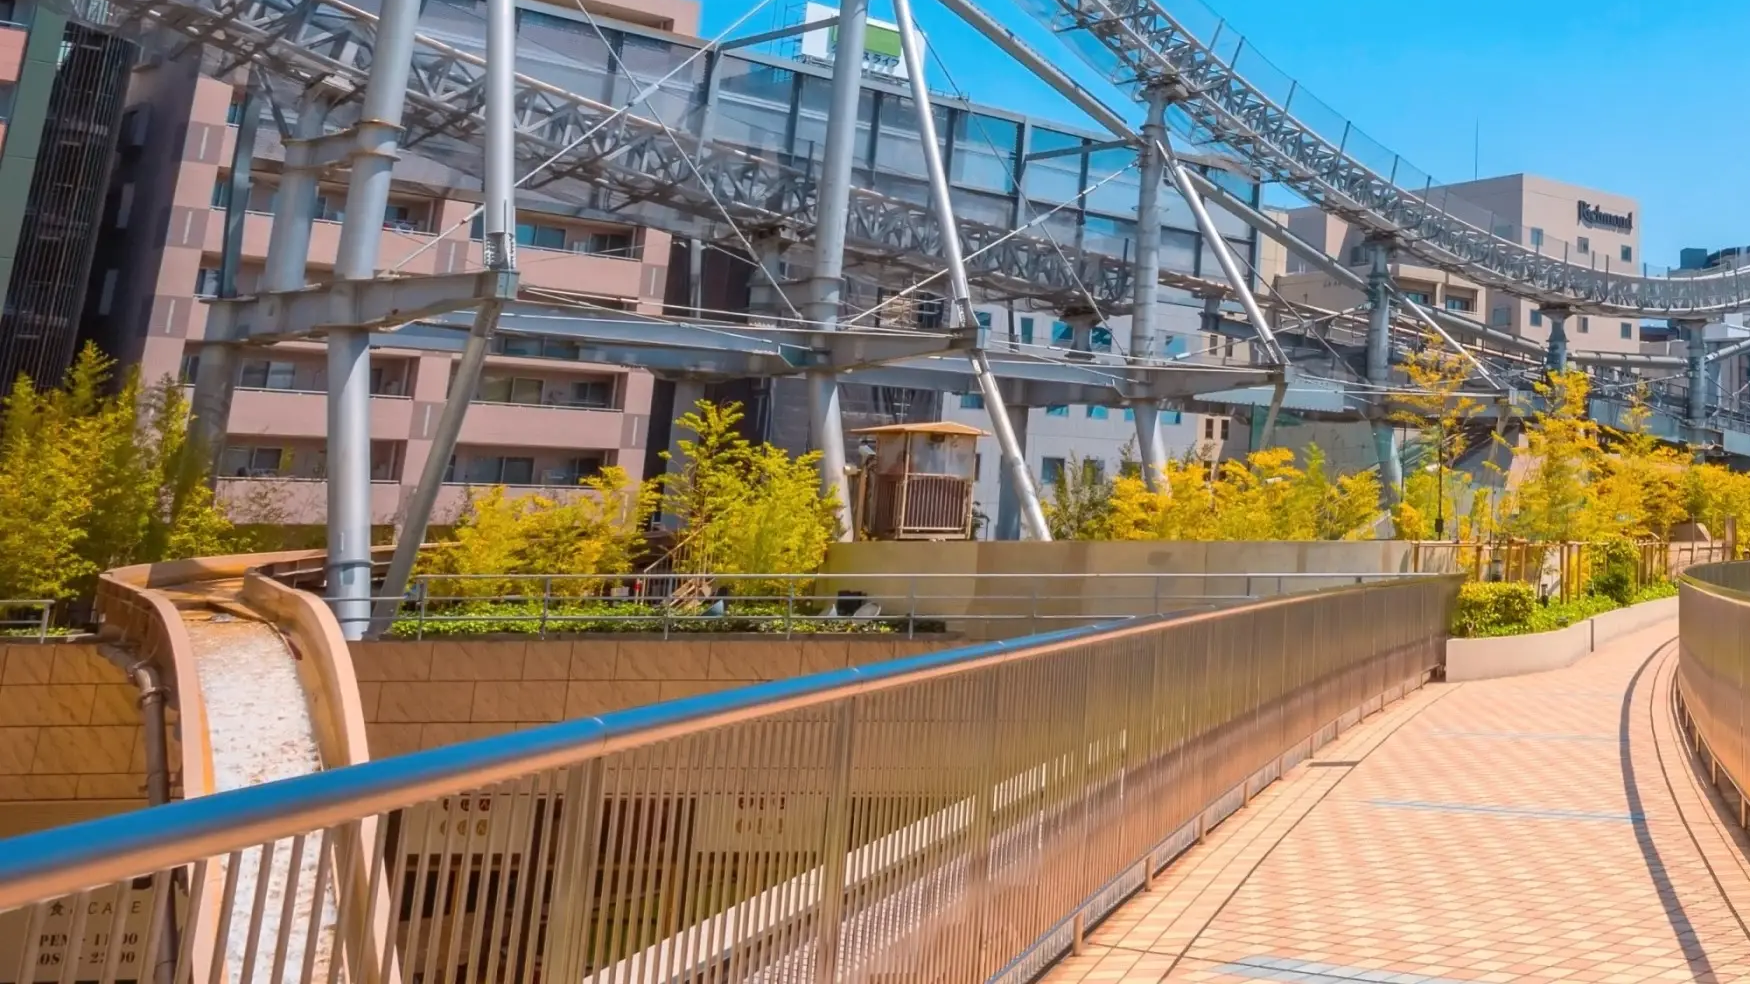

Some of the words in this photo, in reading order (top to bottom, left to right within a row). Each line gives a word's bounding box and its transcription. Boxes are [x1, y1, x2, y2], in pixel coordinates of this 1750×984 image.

[1577, 200, 1632, 229] Richmond
[88, 901, 142, 915] CAE
[39, 933, 67, 947] PEN
